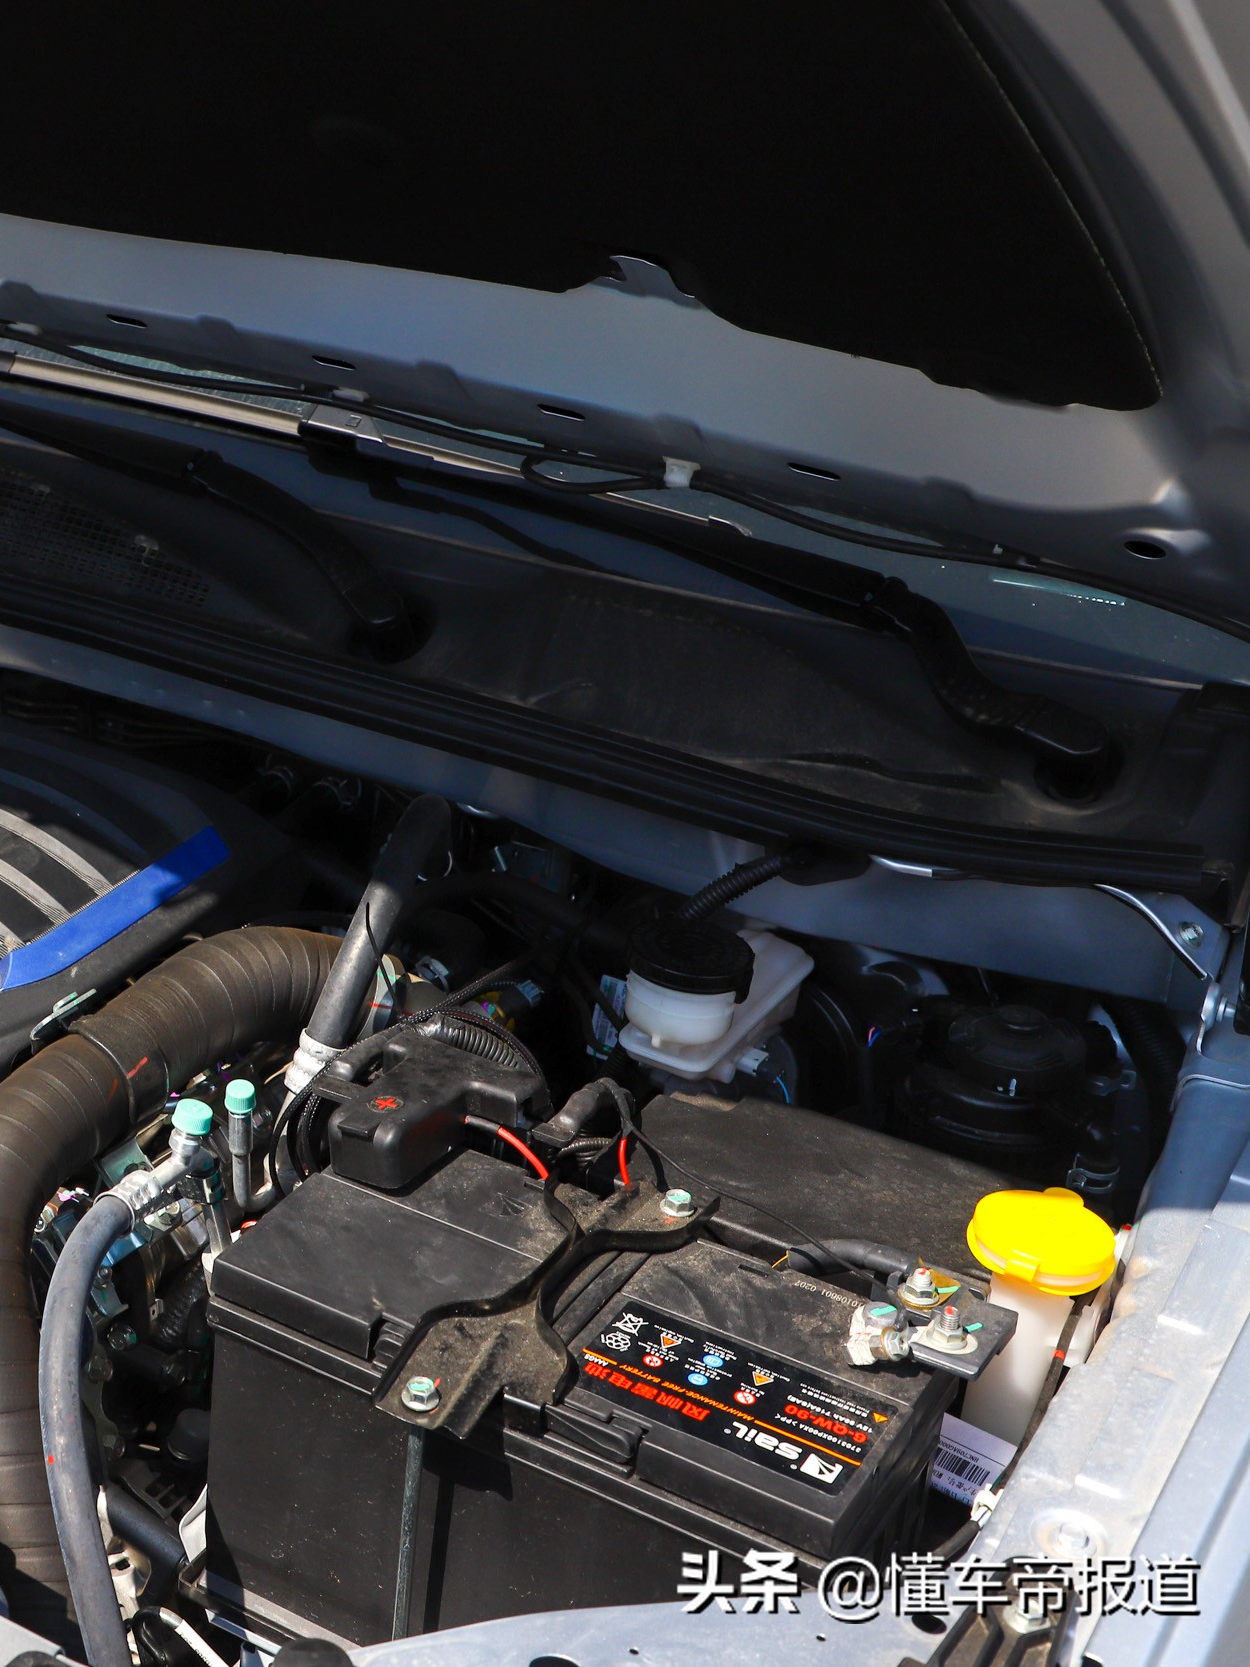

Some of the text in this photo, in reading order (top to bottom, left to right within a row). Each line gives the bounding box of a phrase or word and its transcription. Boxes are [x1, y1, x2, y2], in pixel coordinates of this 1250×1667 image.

[584, 1361, 711, 1421] 风帆蓄电池
[619, 1364, 661, 1383] BATTERY
[660, 1379, 755, 1421] MAINTENANCE-FREE
[784, 1403, 868, 1443] 6-QW-90
